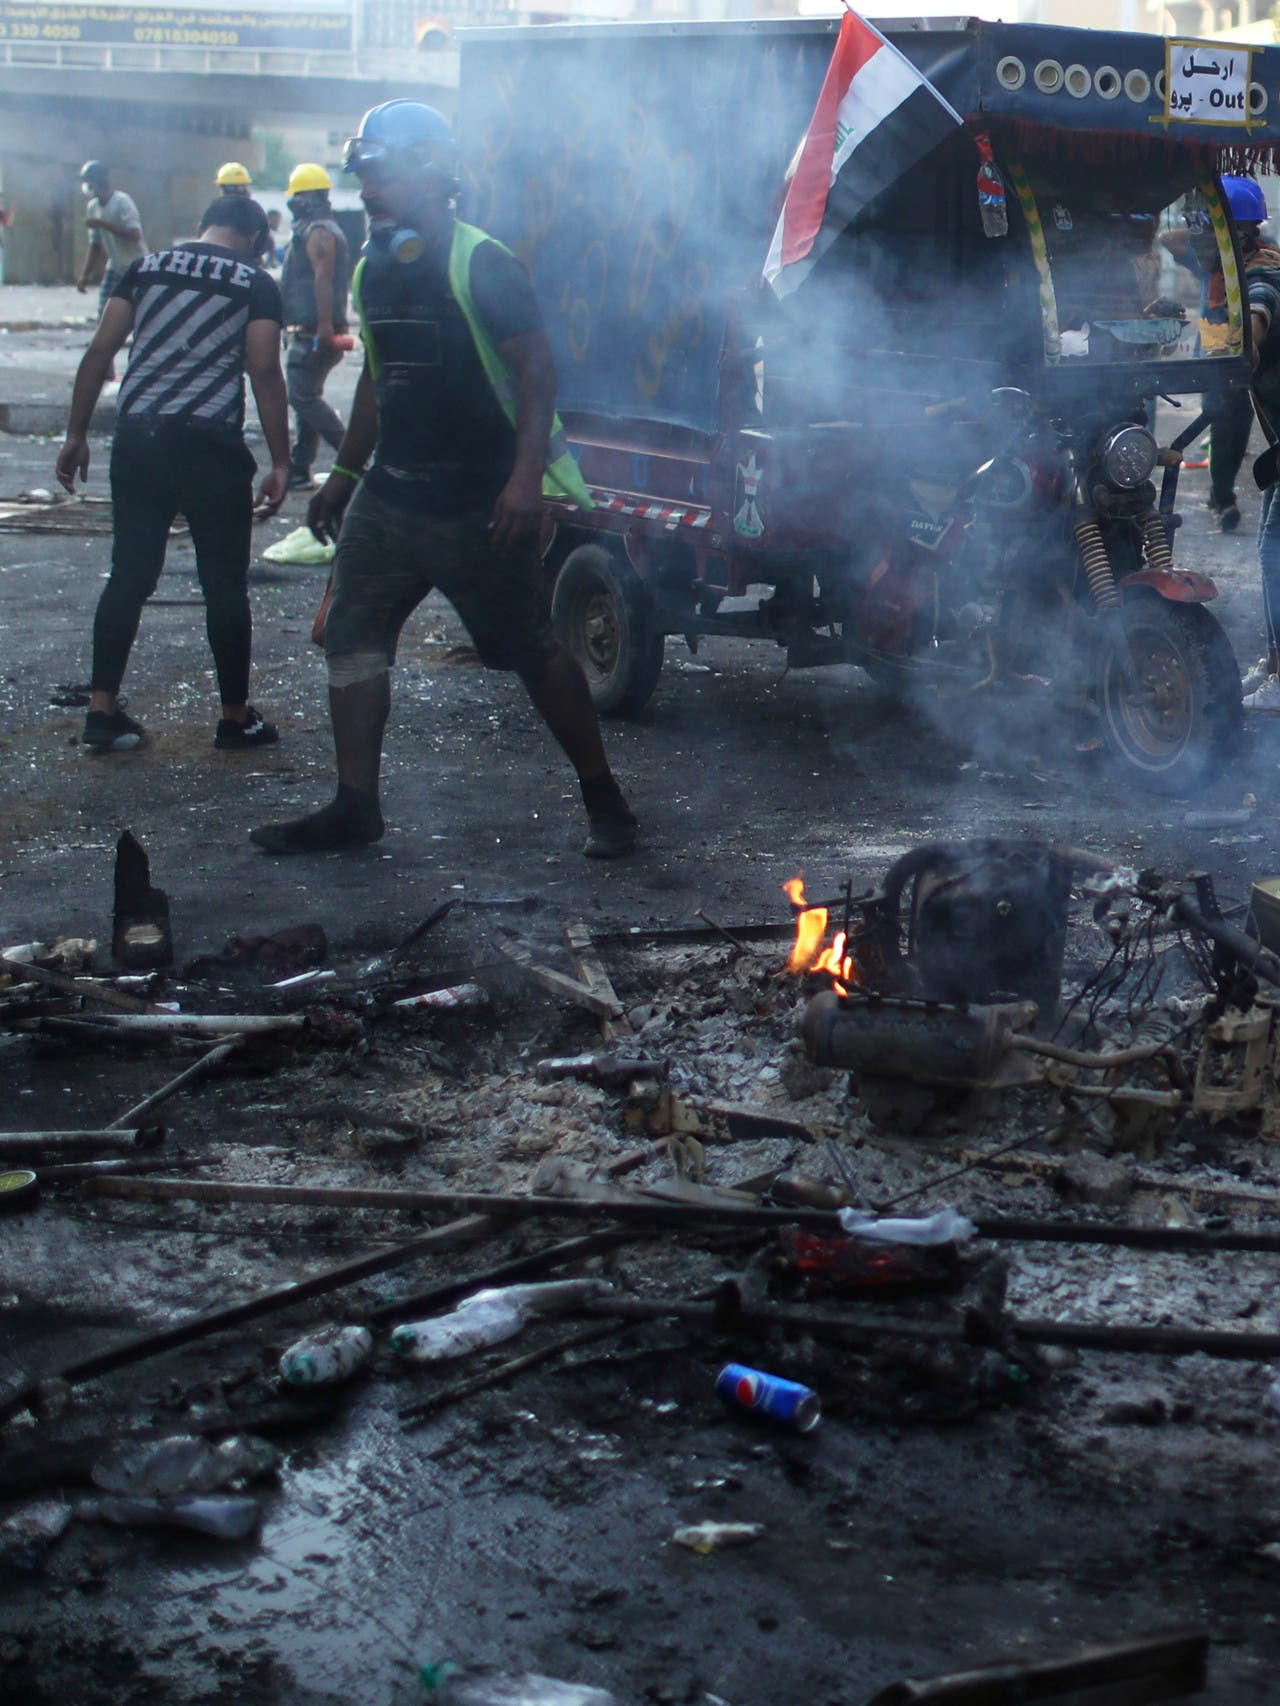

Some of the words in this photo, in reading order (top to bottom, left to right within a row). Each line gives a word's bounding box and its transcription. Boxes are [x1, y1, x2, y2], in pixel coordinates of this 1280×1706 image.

[1182, 54, 1234, 80] ارحل
[1209, 88, 1245, 110] Out
[138, 250, 256, 288] WHITE
